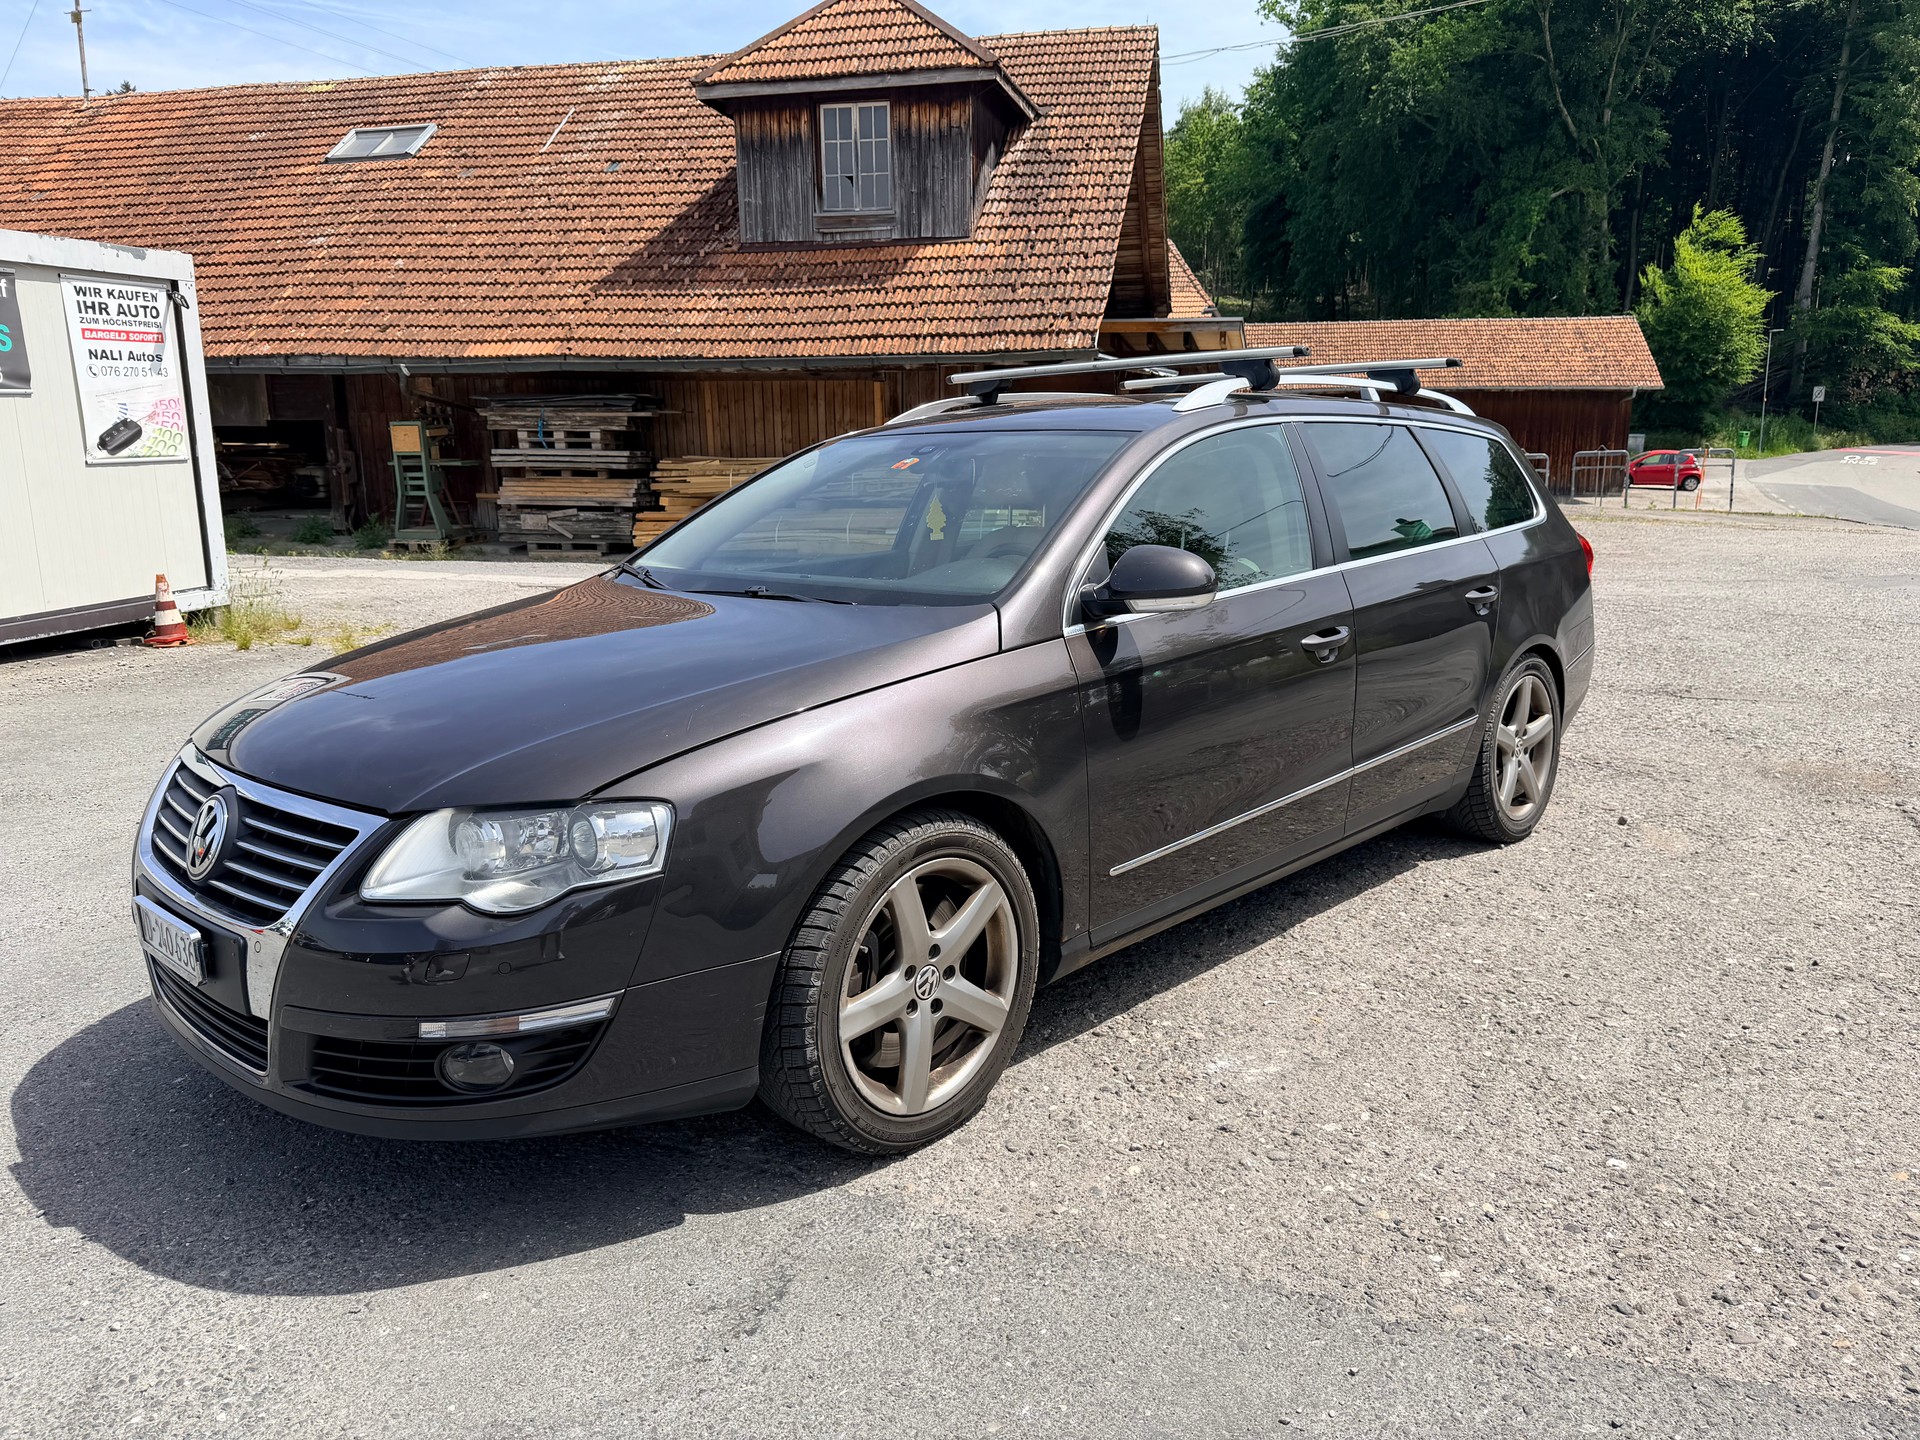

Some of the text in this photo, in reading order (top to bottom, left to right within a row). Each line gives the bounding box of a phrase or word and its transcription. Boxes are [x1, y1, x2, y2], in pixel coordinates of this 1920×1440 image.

[73, 285, 158, 303] WIR KAUFEN
[76, 299, 160, 319] IHR AUTO
[79, 316, 100, 325] ZUM
[84, 330, 162, 342] BARGELD SOFORT!
[87, 348, 163, 363] NALI Autos
[100, 365, 169, 378] 076 270 51 43
